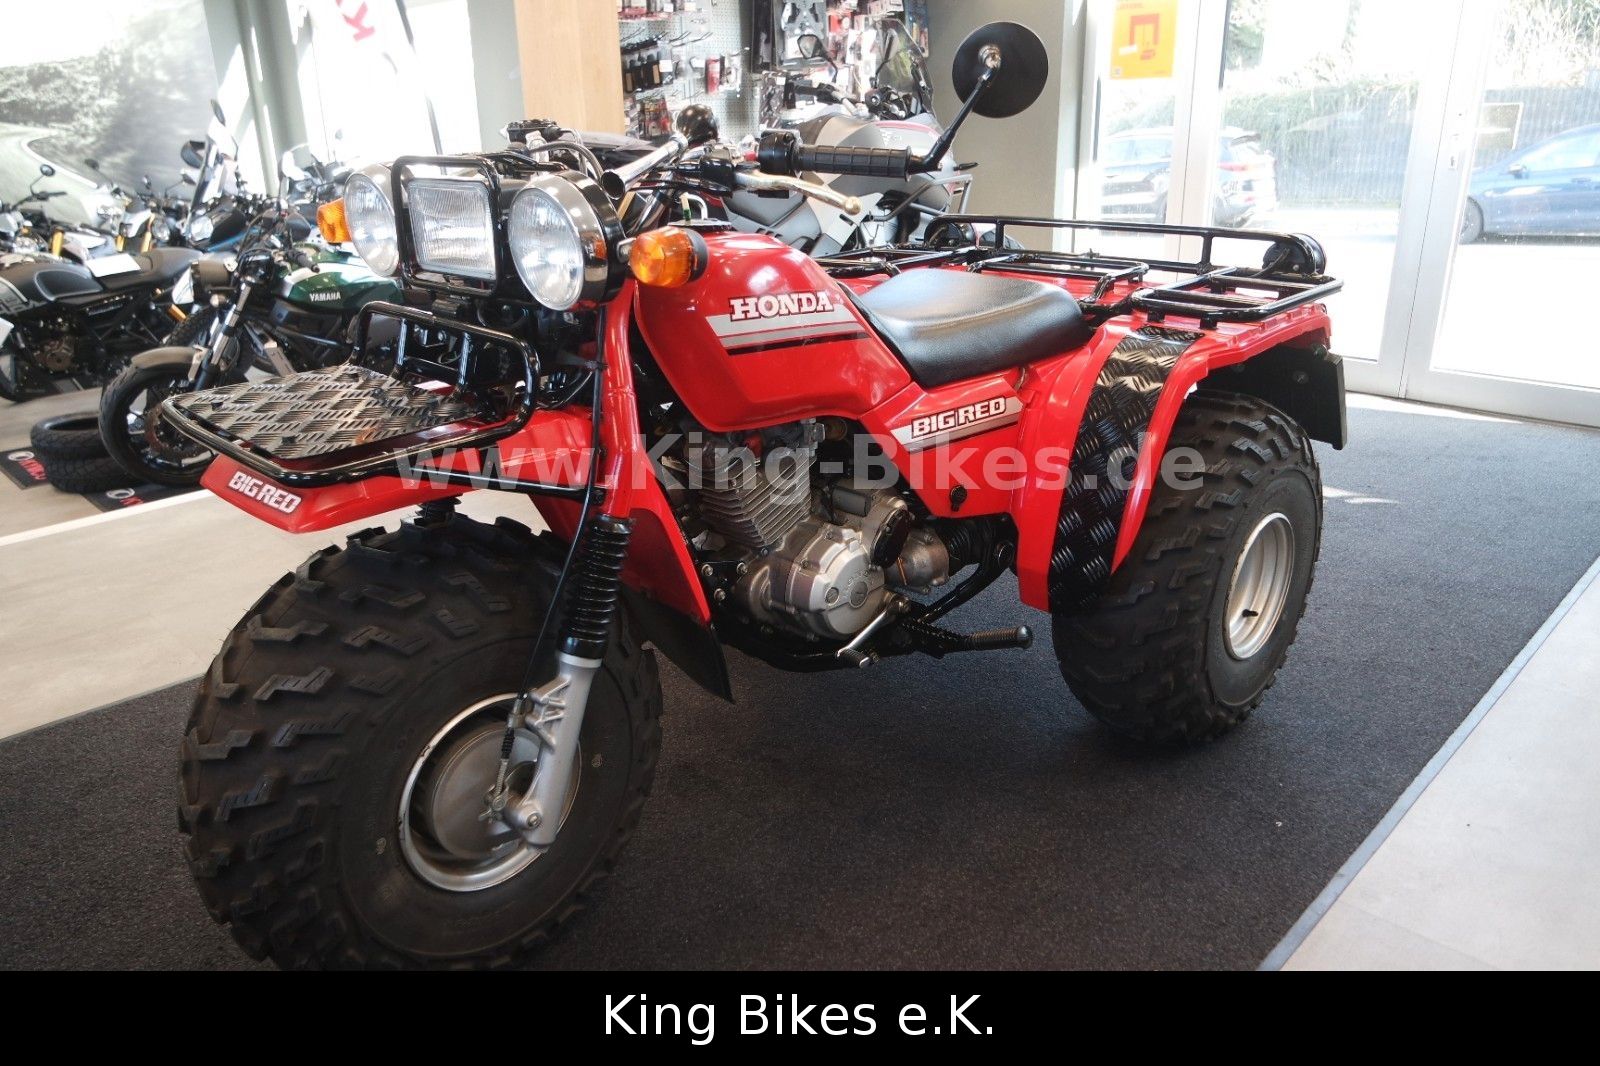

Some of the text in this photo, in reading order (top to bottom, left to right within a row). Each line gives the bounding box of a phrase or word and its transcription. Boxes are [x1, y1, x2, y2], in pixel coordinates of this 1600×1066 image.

[309, 291, 341, 302] YAMAHA
[729, 291, 834, 322] HONDA
[911, 396, 1006, 438] BIG RED
[228, 471, 302, 514] BIG RED
